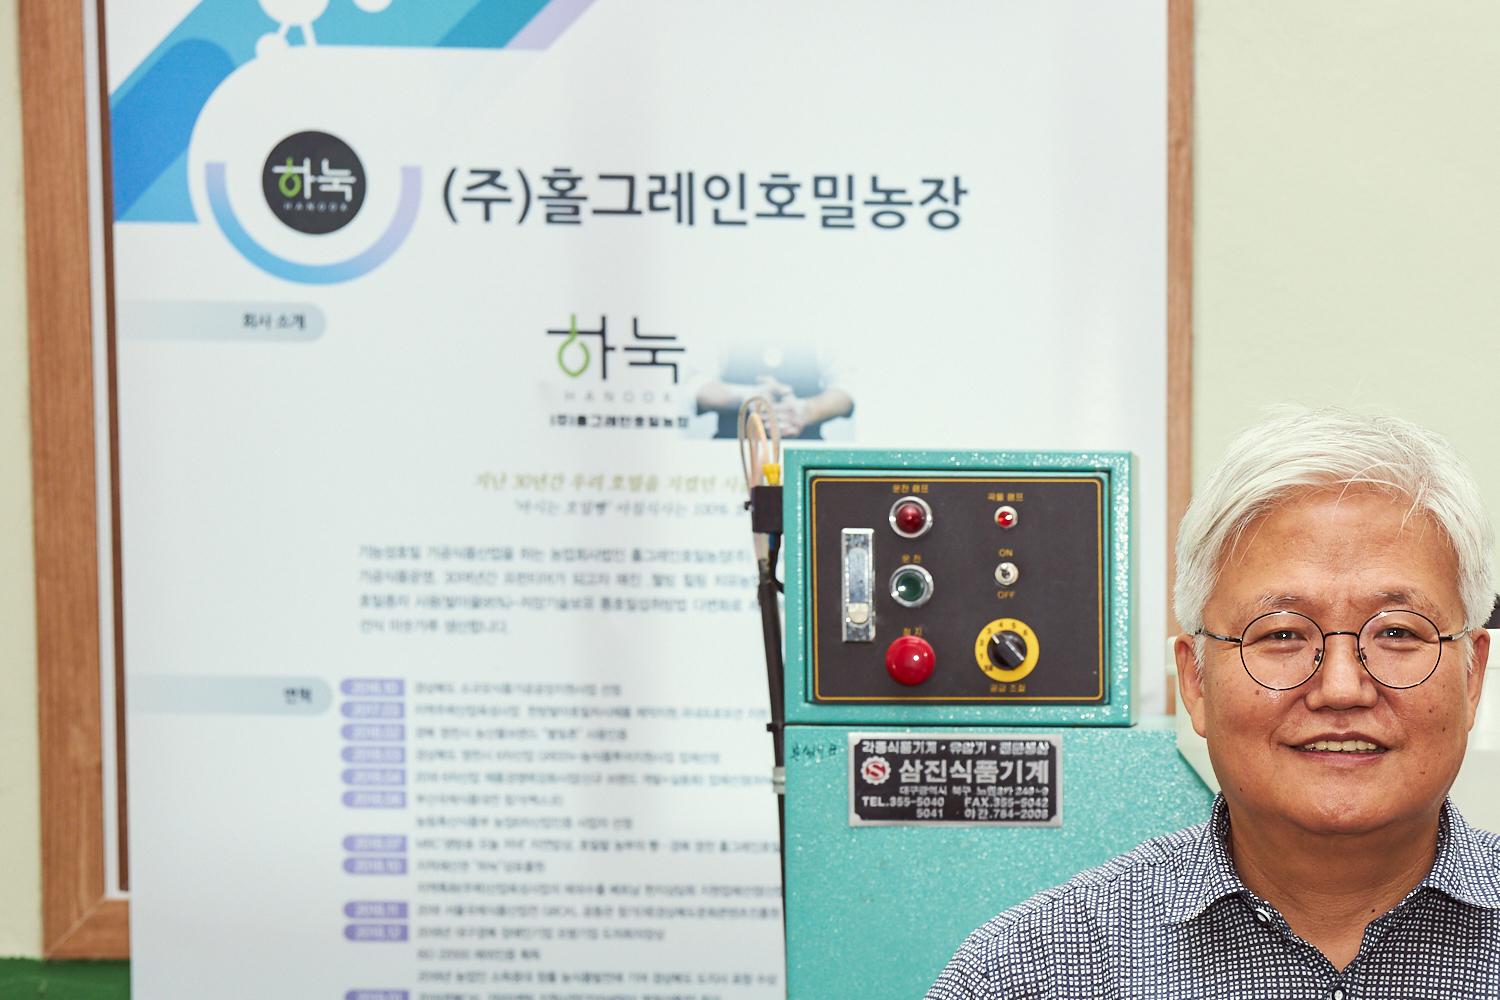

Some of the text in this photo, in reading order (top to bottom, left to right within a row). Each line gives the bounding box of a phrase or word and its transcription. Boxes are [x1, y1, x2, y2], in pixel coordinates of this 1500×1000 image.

[272, 157, 357, 203] 하눅
[442, 166, 968, 231] (주)홀그레인호밀농장
[242, 312, 306, 331] 회사 소개
[546, 313, 686, 384] 하눅
[999, 549, 1013, 557] ON
[997, 591, 1015, 599] OFF
[862, 741, 937, 755] 각종식품기계
[898, 759, 1050, 784] 삼진식품기계
[862, 796, 1049, 808] TEL.355-5040 FAX.355-5042
[916, 809, 944, 819] 5041
